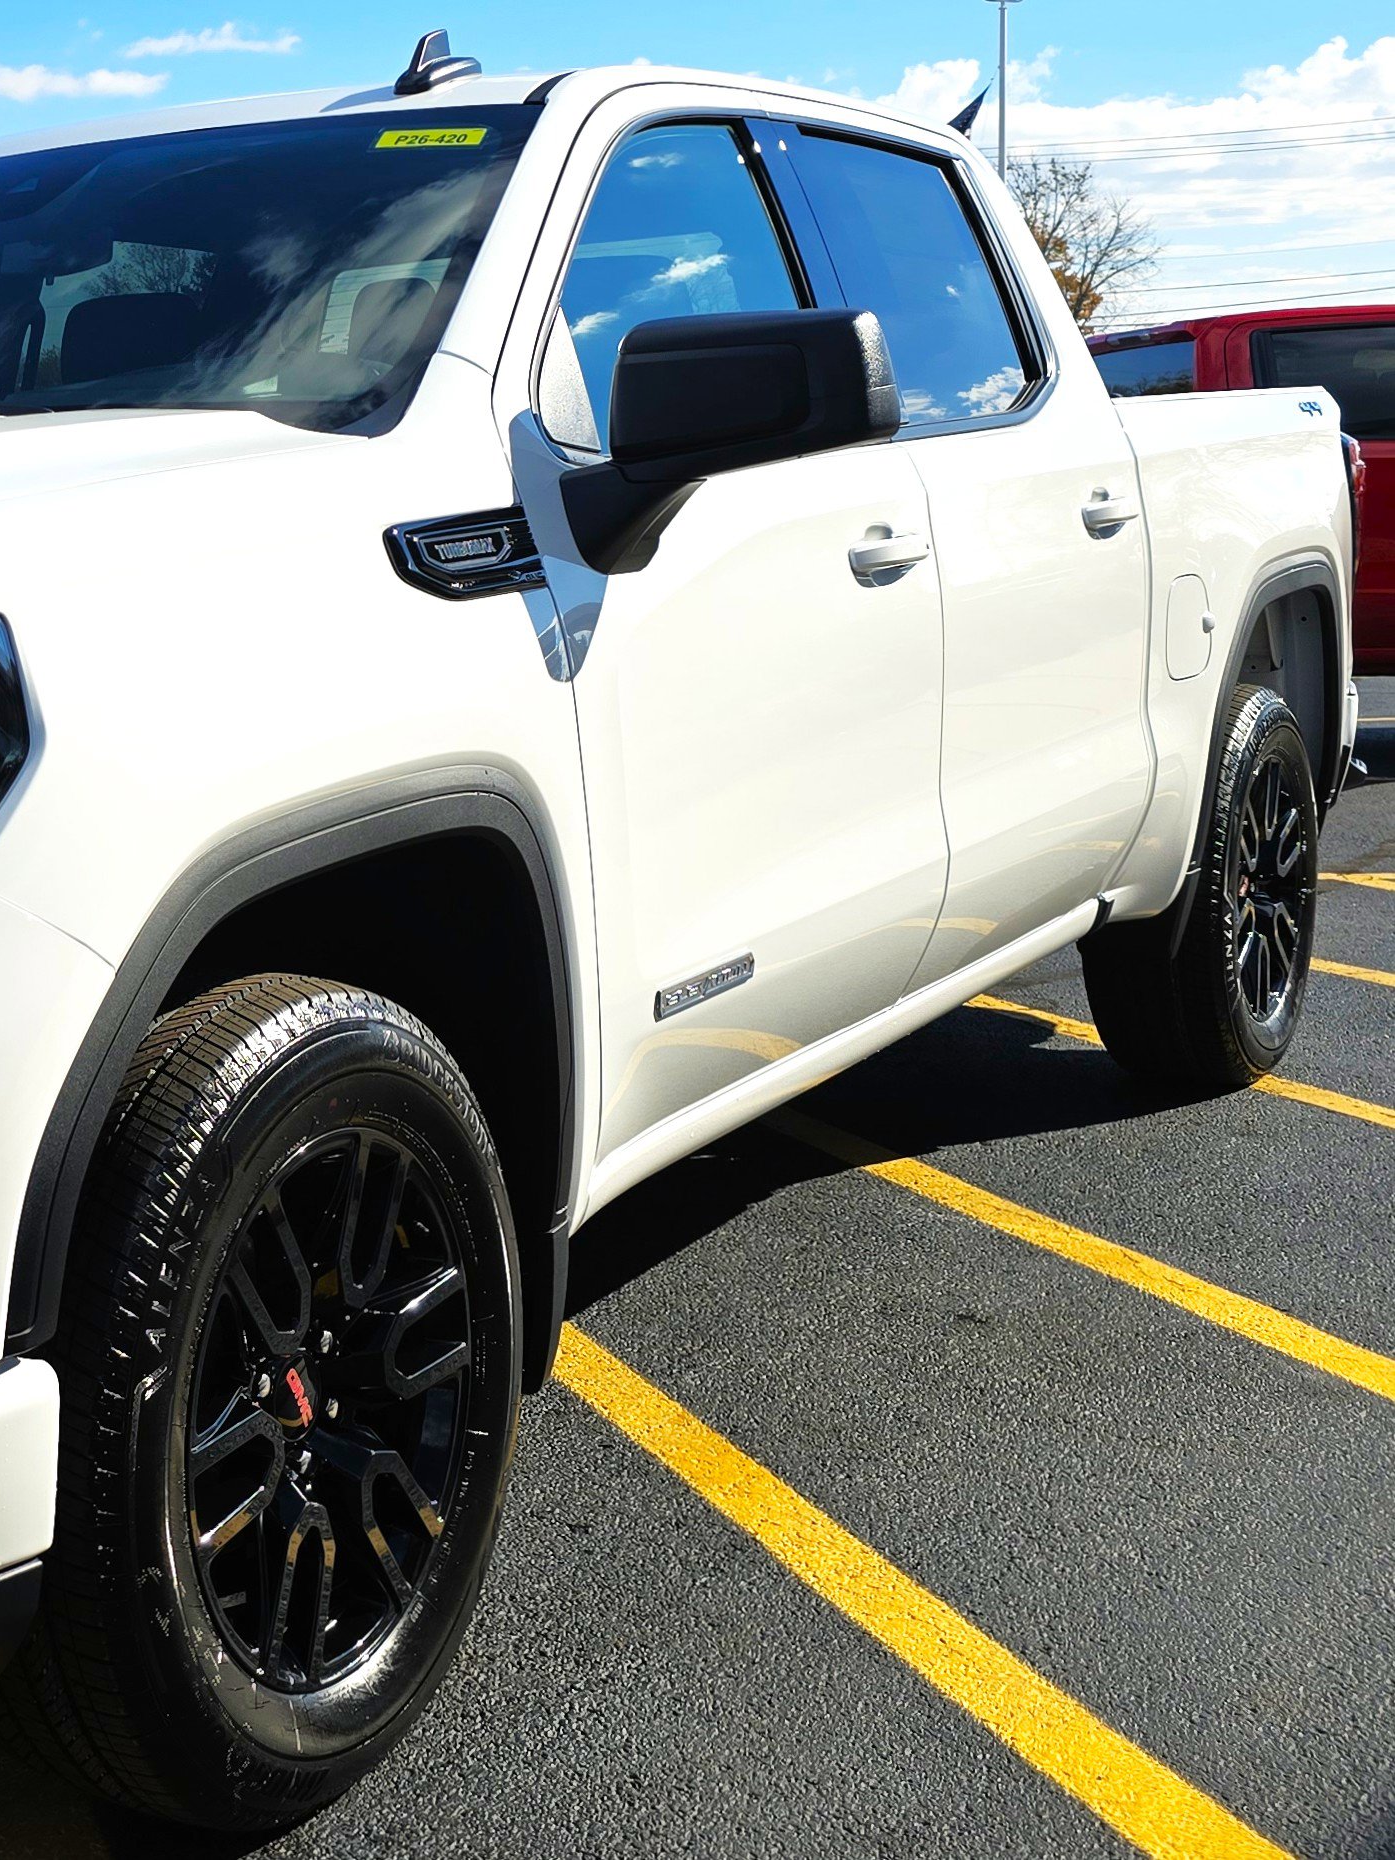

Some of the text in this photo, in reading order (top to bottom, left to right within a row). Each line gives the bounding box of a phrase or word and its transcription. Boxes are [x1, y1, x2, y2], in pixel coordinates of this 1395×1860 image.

[394, 133, 468, 145] P26-420
[435, 537, 496, 560] TURBOMAX
[382, 1029, 496, 1169] BRIDGESTONE
[286, 1368, 313, 1427] GMC
